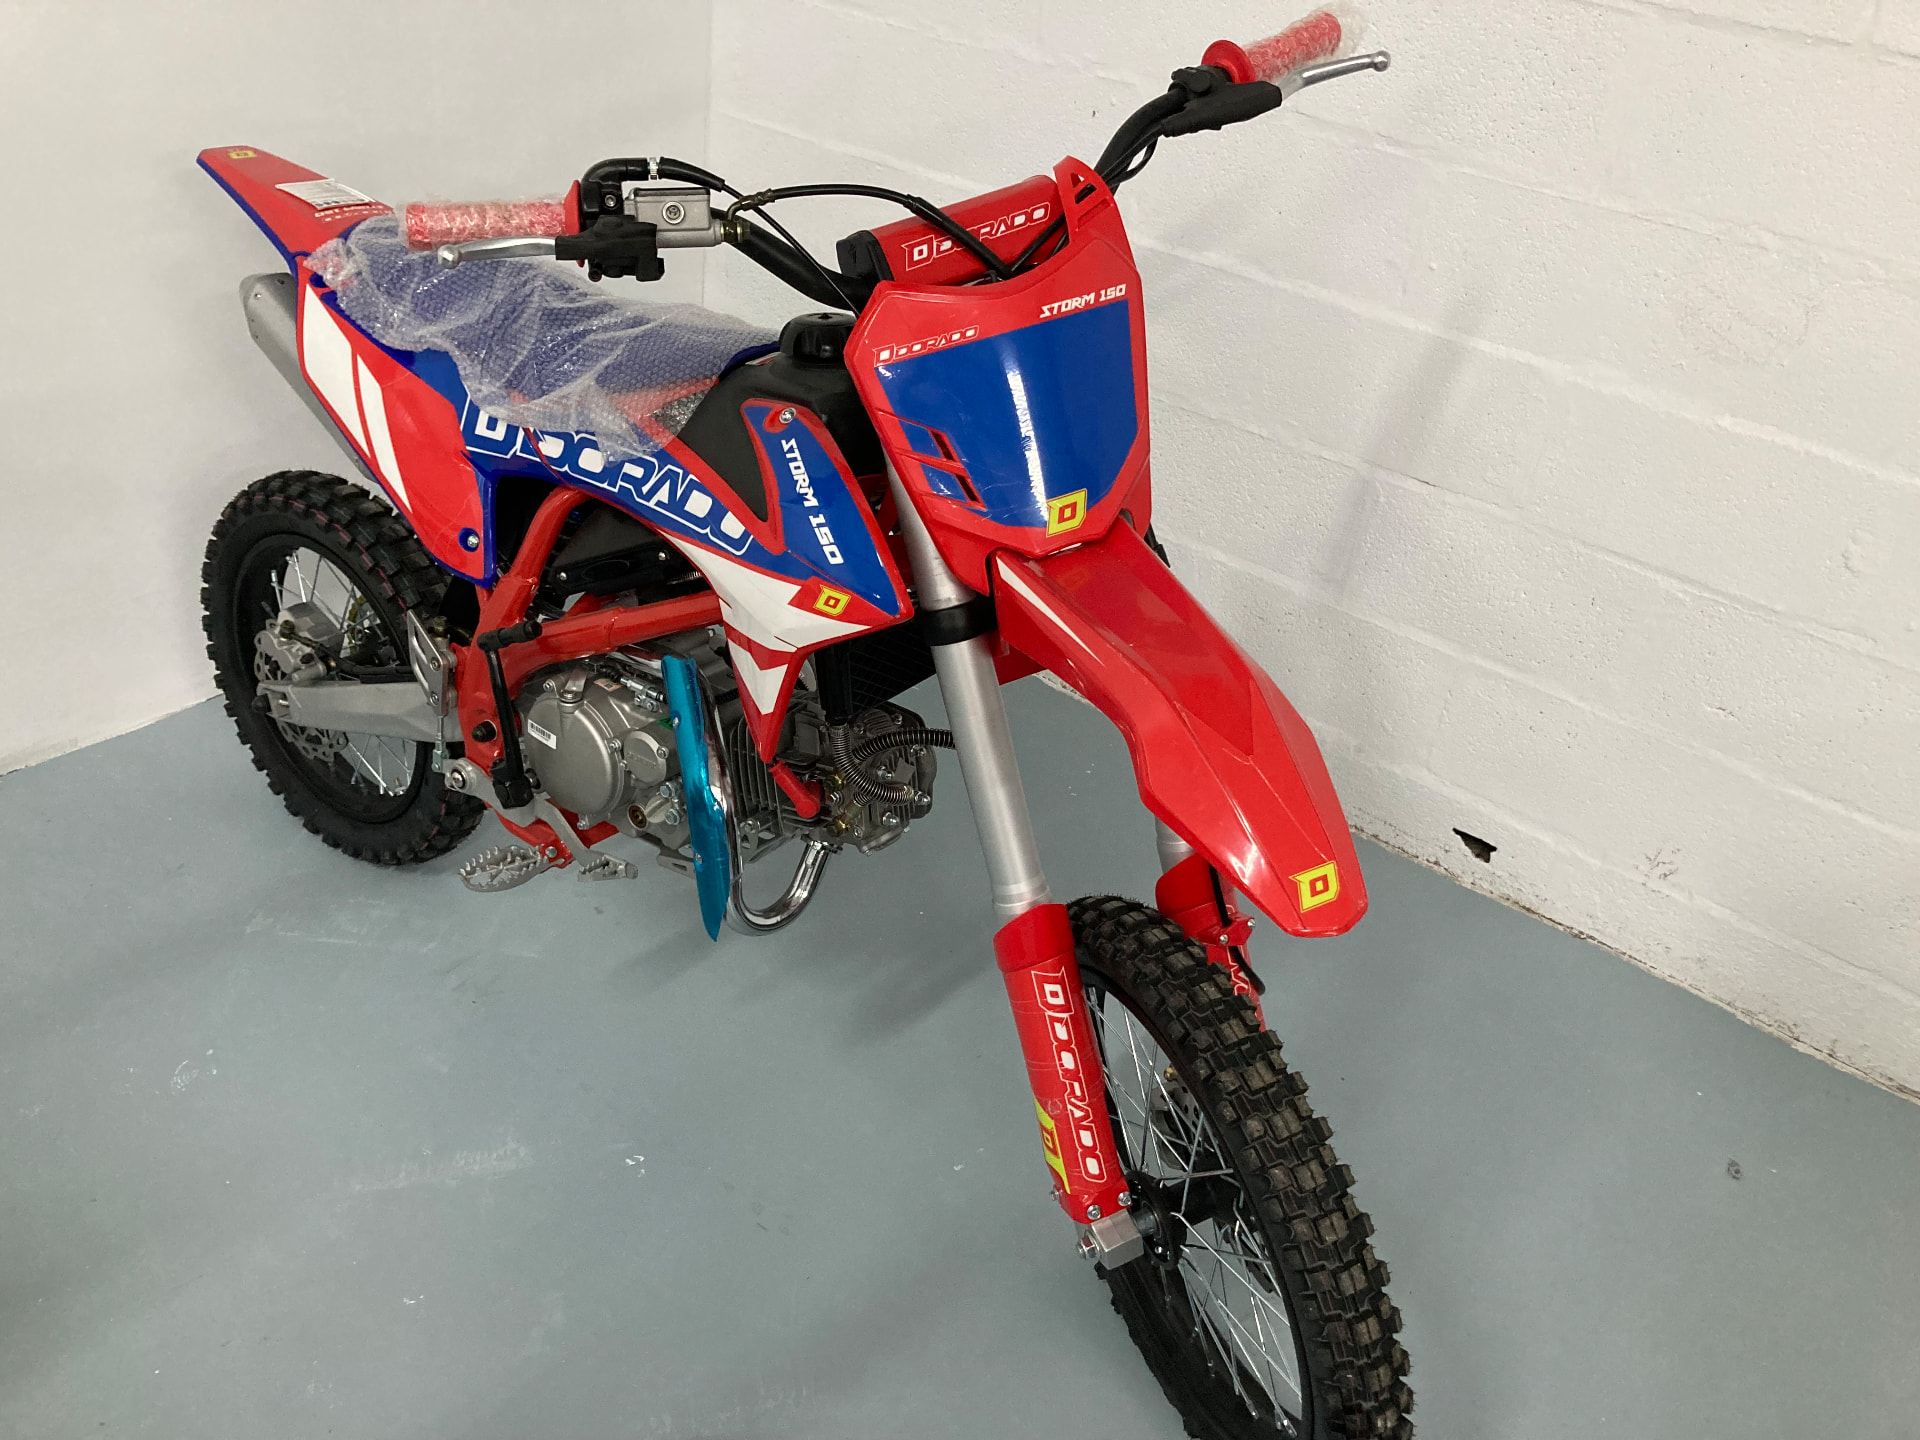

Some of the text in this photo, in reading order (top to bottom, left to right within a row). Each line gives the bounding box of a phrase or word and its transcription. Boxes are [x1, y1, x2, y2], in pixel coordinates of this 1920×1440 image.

[934, 201, 1051, 259] DRADO
[1039, 283, 1127, 319] STORM 150
[894, 324, 980, 360] DORADO
[781, 438, 844, 565] STORM 150
[1045, 1011, 1107, 1183] DORADO
